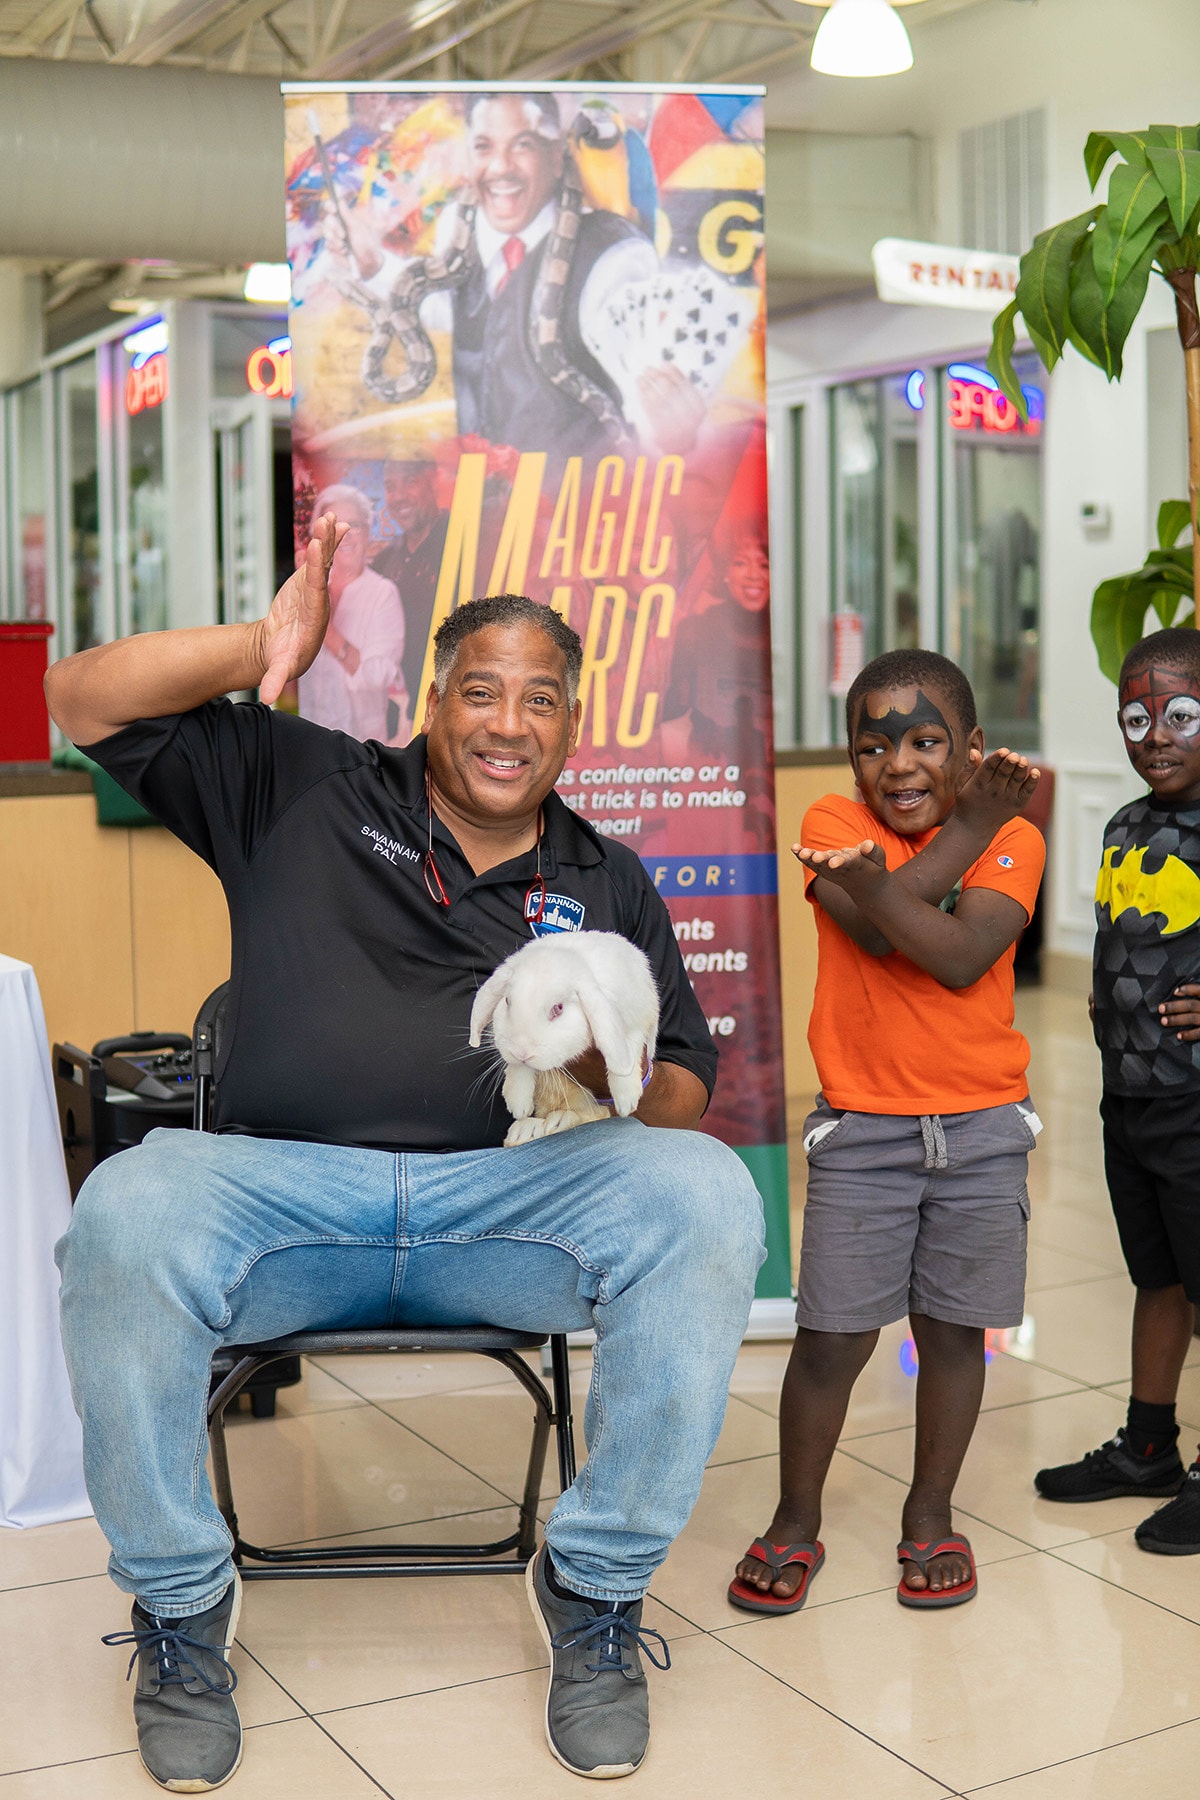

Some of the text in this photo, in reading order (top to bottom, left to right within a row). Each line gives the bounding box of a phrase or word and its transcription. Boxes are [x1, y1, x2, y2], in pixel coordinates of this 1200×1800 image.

[579, 764, 695, 785] conference
[698, 765, 722, 783] or
[724, 765, 740, 782] a
[591, 789, 636, 810] trick
[639, 788, 658, 809] is
[662, 789, 684, 809] to
[687, 786, 747, 808] make
[360, 825, 421, 863] SAVANNAH
[372, 842, 398, 866] PAL
[654, 865, 736, 888] FOR:
[673, 917, 716, 941] nts
[682, 948, 748, 973] vents
